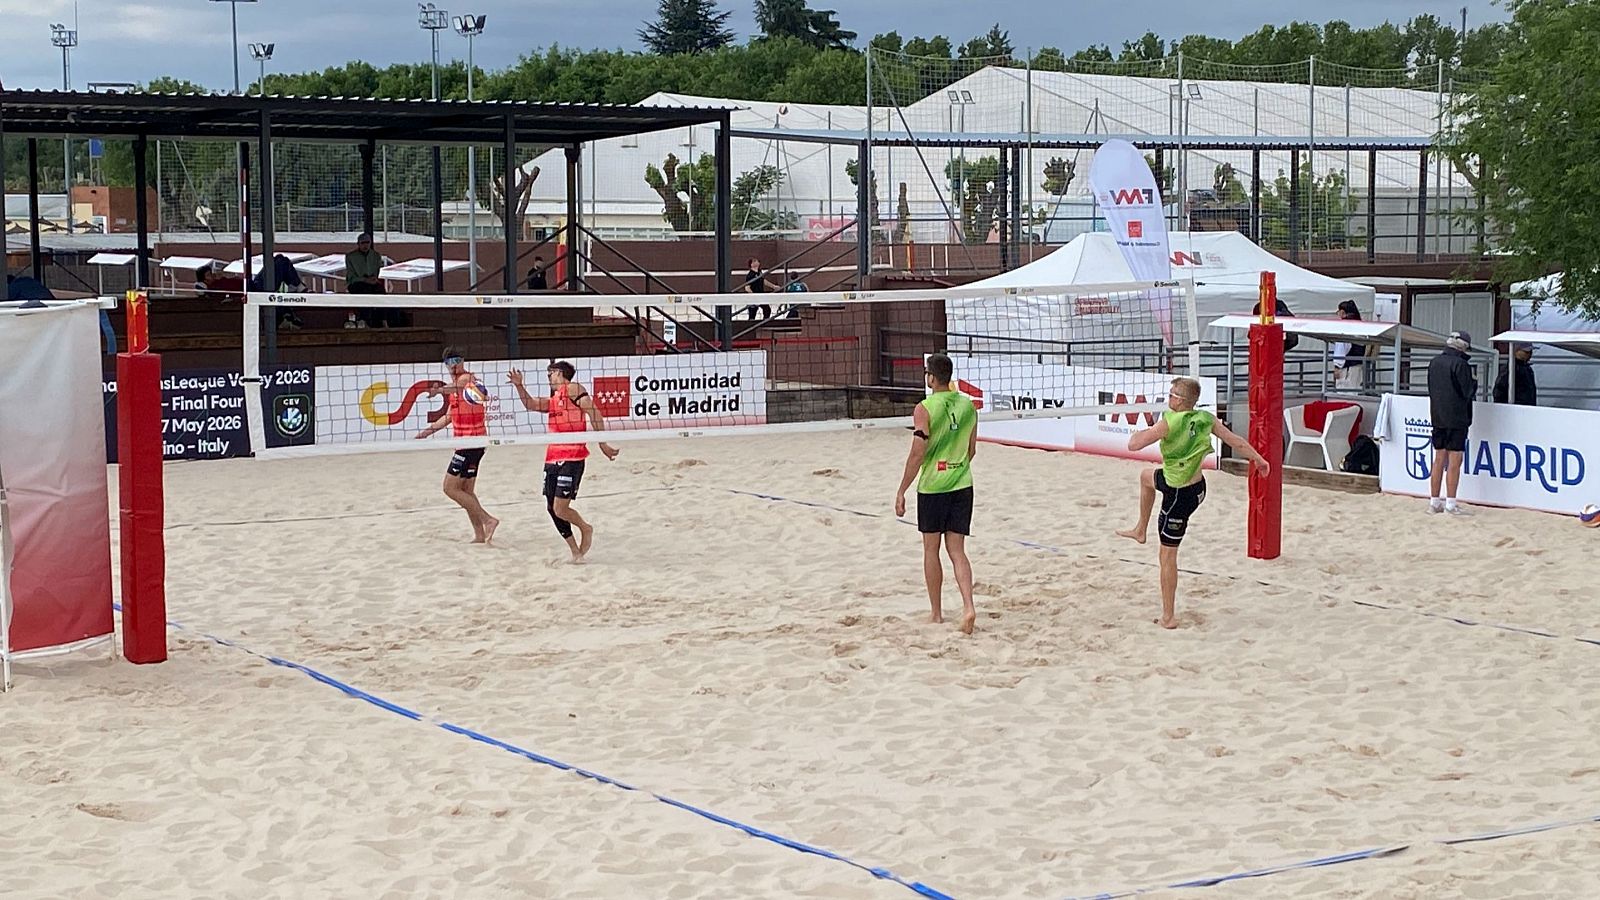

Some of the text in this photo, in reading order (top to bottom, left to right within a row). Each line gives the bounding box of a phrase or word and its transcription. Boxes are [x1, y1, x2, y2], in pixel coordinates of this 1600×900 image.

[277, 295, 306, 303] Senoh
[276, 370, 309, 384] 2026
[635, 372, 740, 391] Comunidad
[172, 395, 207, 411] Final
[211, 395, 243, 409] Four
[635, 395, 739, 416] de Madrid
[172, 418, 205, 434] May
[208, 416, 241, 430] 2026
[198, 438, 229, 454] Italy
